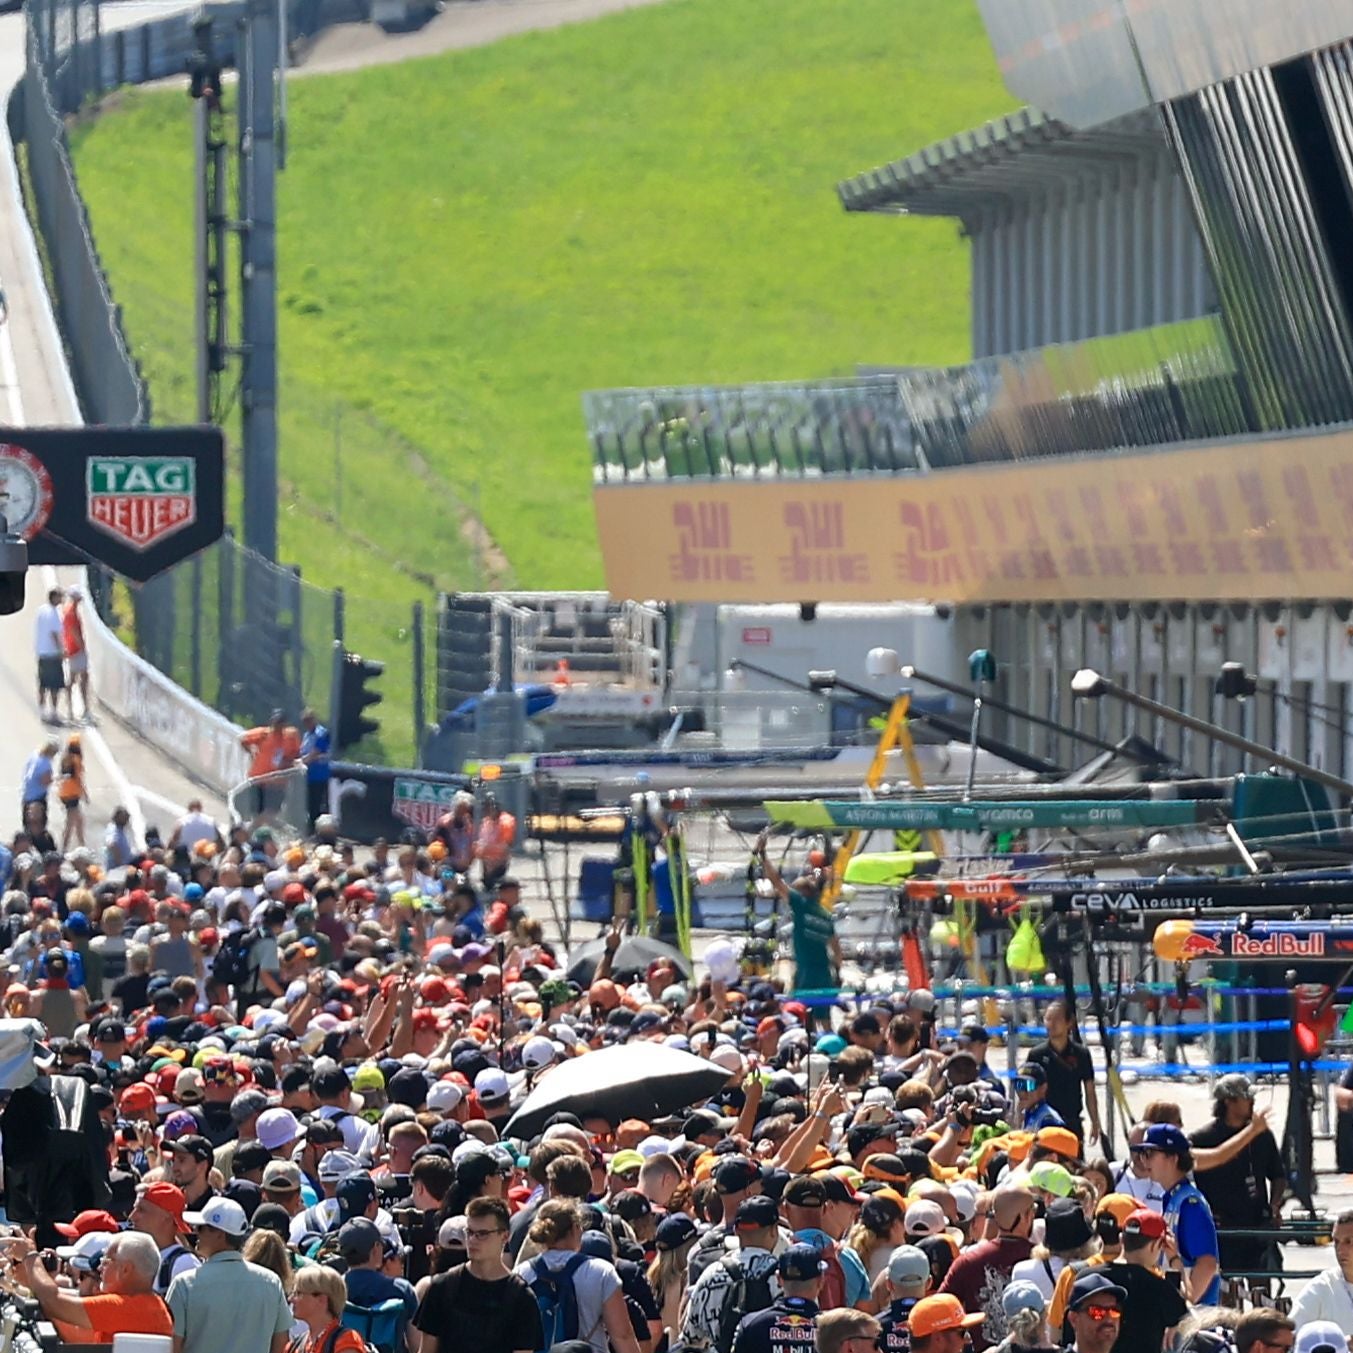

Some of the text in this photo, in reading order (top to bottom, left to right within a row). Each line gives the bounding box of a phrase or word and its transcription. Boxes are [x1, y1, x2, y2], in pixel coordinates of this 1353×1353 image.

[97, 463, 185, 491] TAG
[94, 497, 187, 540] HEUER
[1143, 897, 1213, 908] LOGISTICS
[1231, 932, 1324, 955] Red Bull
[770, 1327, 793, 1341] Red
